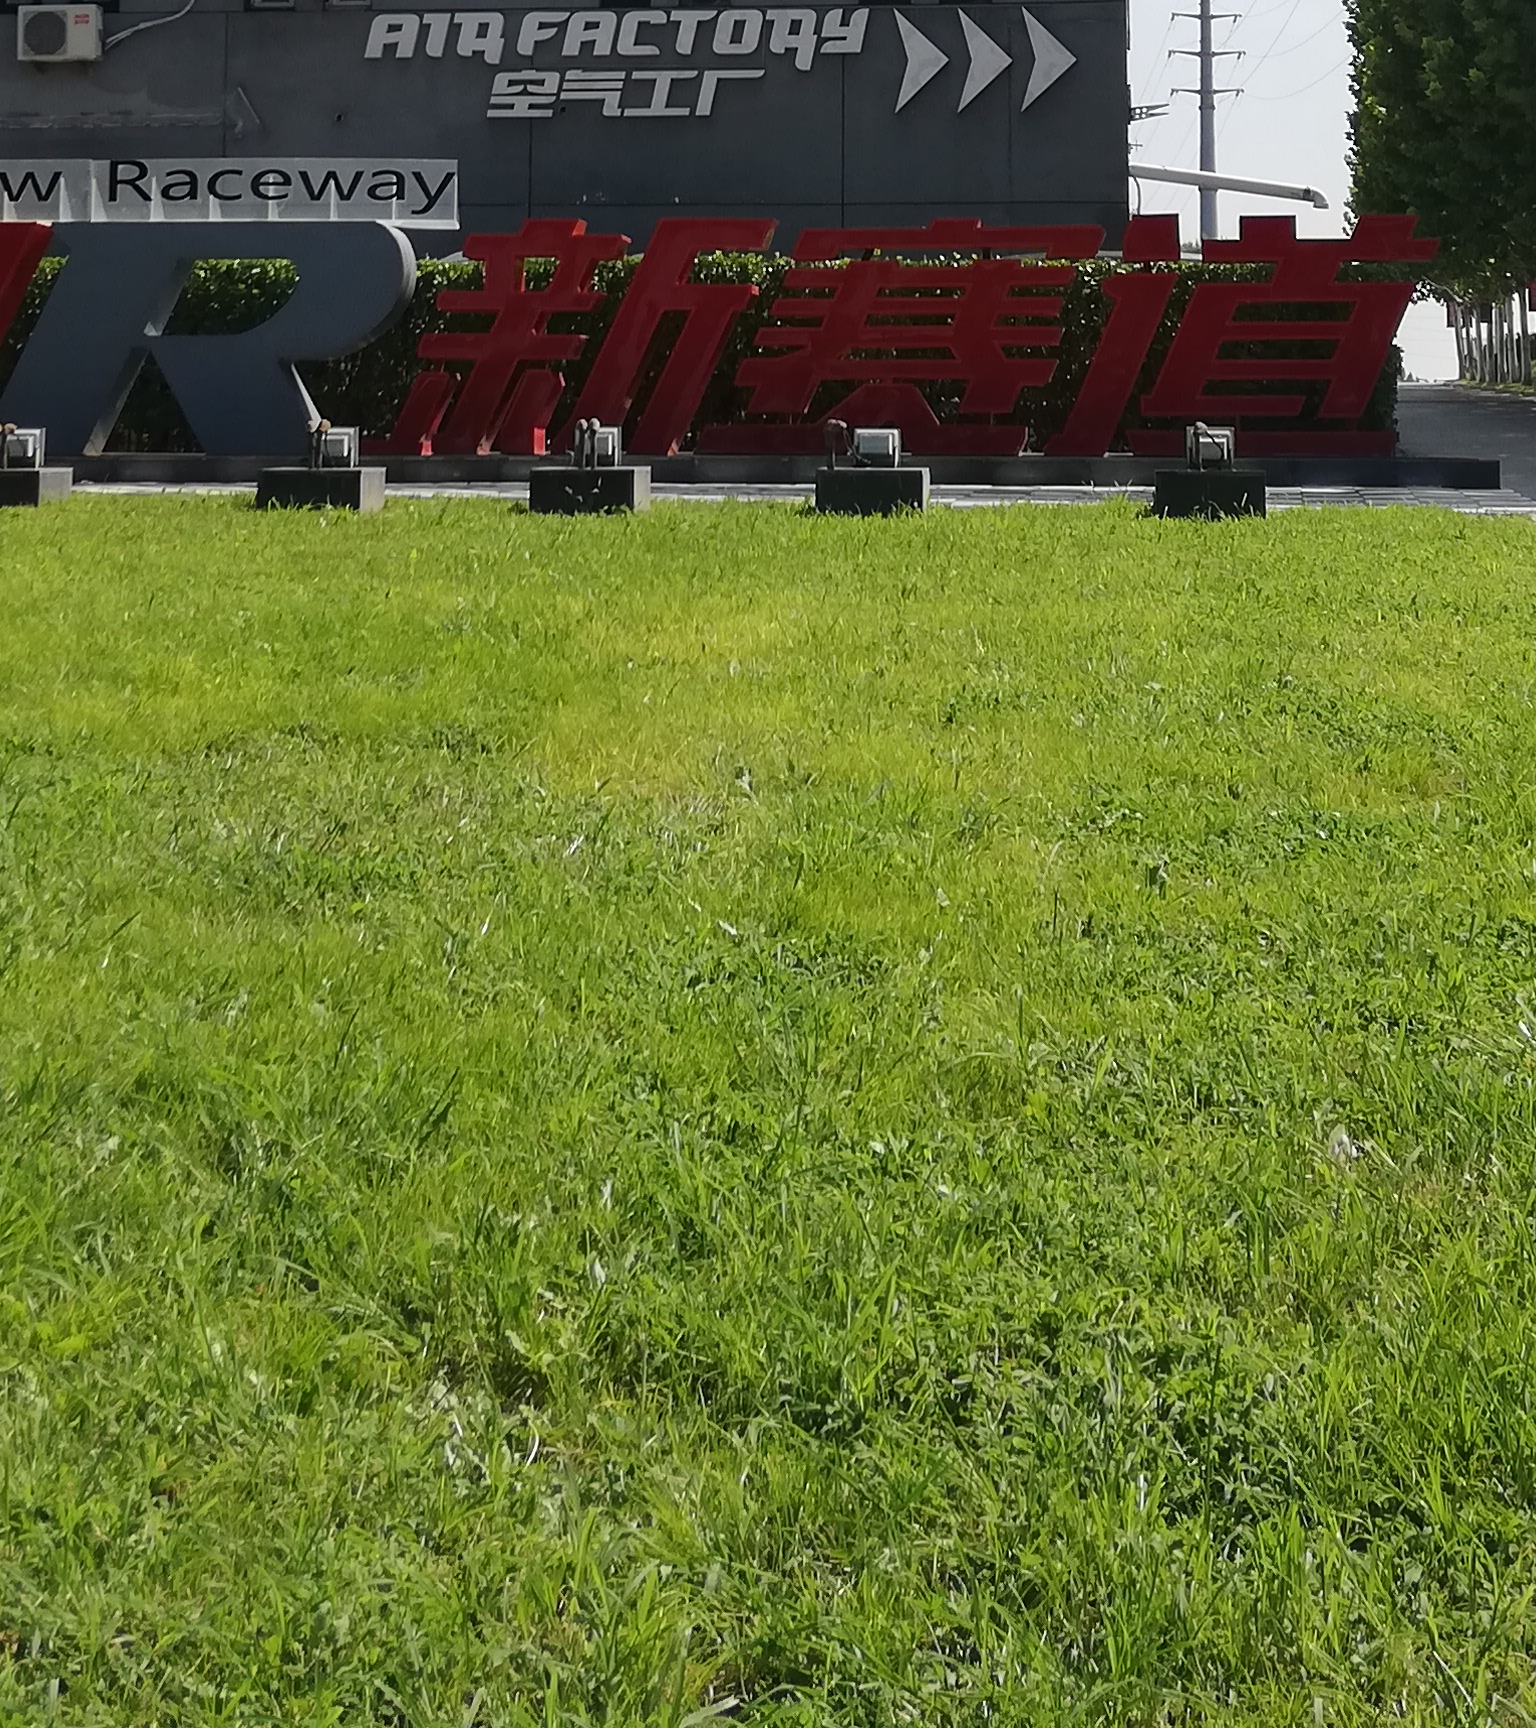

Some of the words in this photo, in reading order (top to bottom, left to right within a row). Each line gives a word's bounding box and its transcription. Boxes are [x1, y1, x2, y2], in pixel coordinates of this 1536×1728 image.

[365, 12, 505, 65] AIR
[517, 8, 870, 71] FACTORY
[486, 69, 766, 118] 空气工厂
[108, 159, 456, 215] Raceway
[360, 214, 1443, 457] 新赛道
